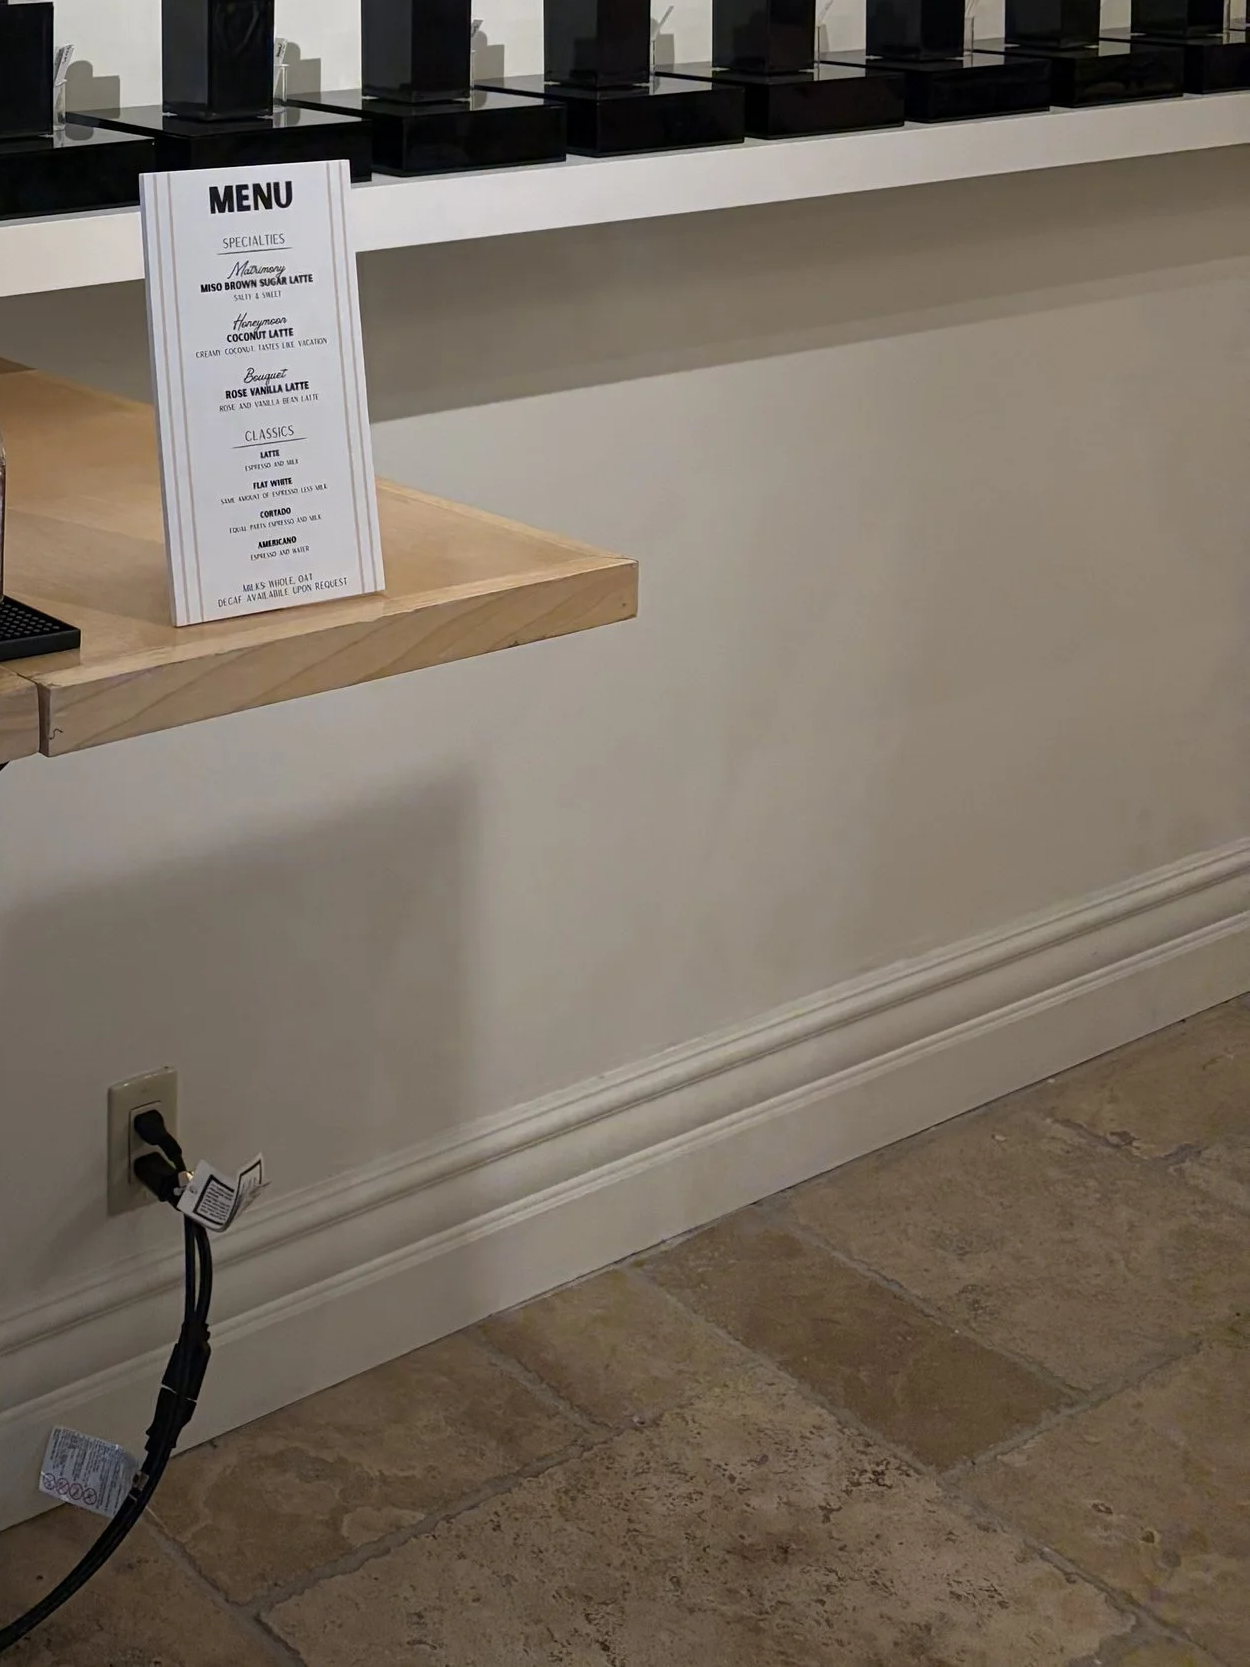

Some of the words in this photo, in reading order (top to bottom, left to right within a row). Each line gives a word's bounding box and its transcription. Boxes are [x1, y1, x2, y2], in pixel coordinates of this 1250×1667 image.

[209, 181, 293, 214] MENU
[223, 234, 285, 249] SPECIALTIES
[227, 261, 286, 278] Matrimony
[201, 283, 222, 293] MISO
[225, 279, 257, 292] BROWN
[259, 275, 287, 287] SUGAR
[289, 274, 313, 285] LATTE
[233, 313, 287, 331] Honeymoon
[227, 330, 266, 343] COCONUT
[269, 328, 294, 339] LATTE
[298, 338, 328, 347] VACATION
[244, 368, 288, 385] Bouquet
[226, 389, 247, 399] ROSE
[250, 384, 283, 396] VANILLA
[285, 381, 310, 392] LATTE
[254, 399, 280, 408] VANILLA
[245, 425, 295, 442] CLASSICS
[260, 450, 280, 459] LATTE
[253, 481, 268, 490] FLAT
[270, 478, 293, 487] WHITE
[260, 507, 291, 518] CORTADO
[258, 536, 297, 549] AMERICANO
[298, 573, 313, 583] OAT
[218, 596, 242, 607] DECAF
[293, 584, 312, 594] UPON
[315, 577, 348, 591] REQUEST
